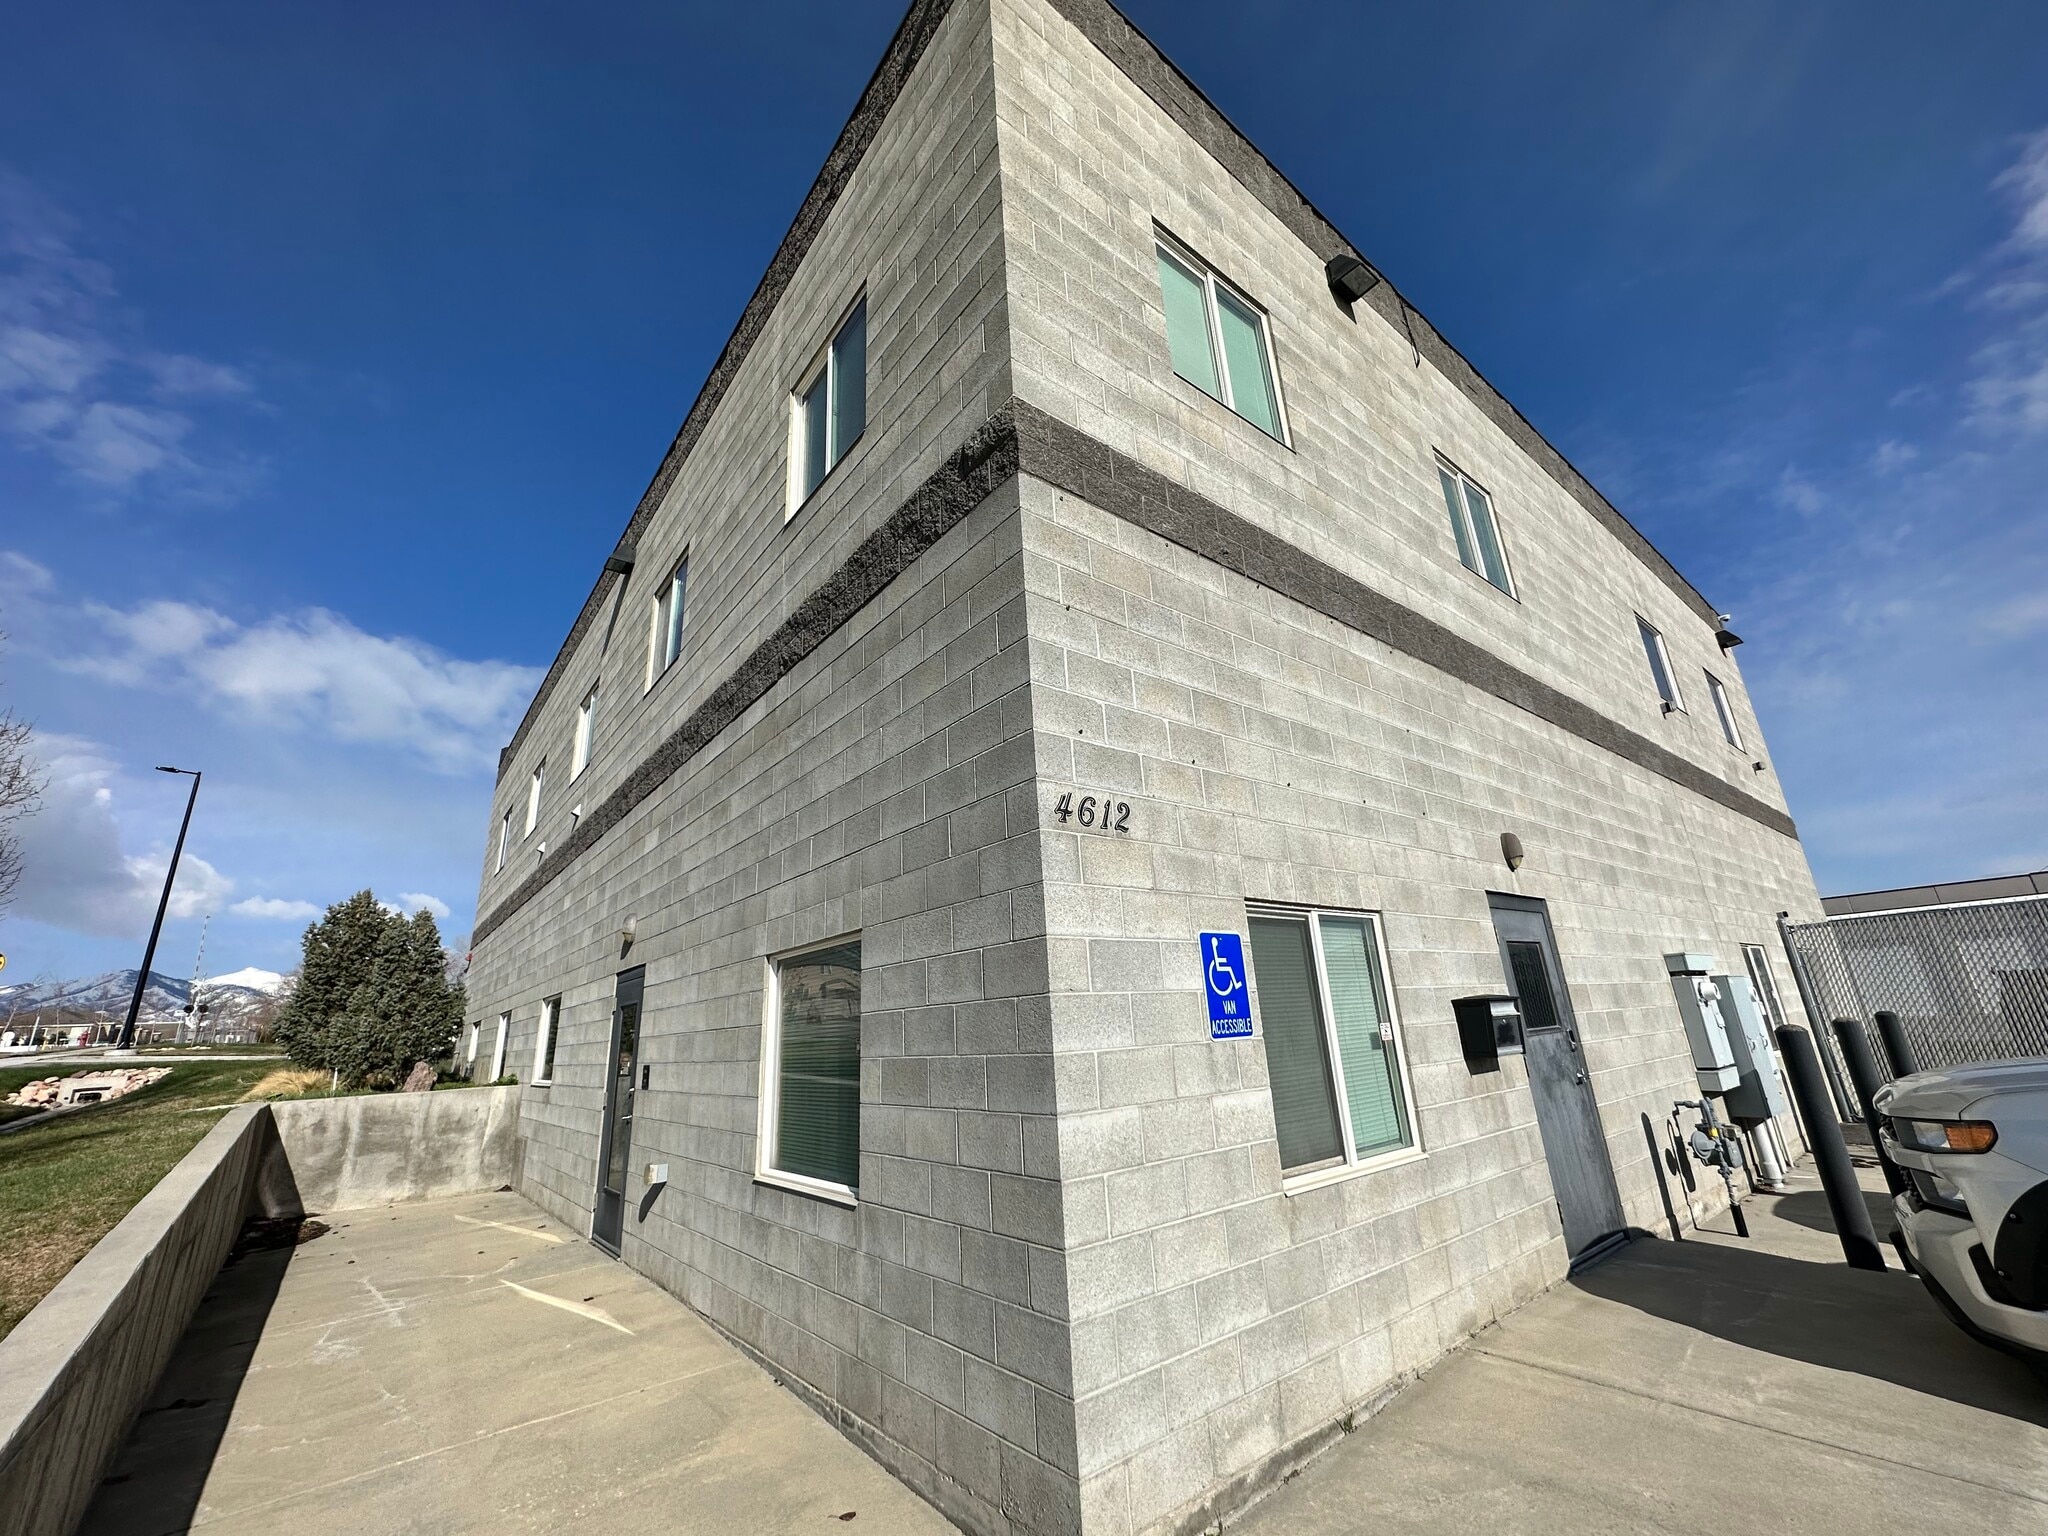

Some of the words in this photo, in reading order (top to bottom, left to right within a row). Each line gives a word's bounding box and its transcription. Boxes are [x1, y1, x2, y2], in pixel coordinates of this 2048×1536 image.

[1054, 792, 1131, 833] 4612
[1223, 1000, 1237, 1015] VAN
[1212, 1018, 1252, 1034] ACCESSIBLE
